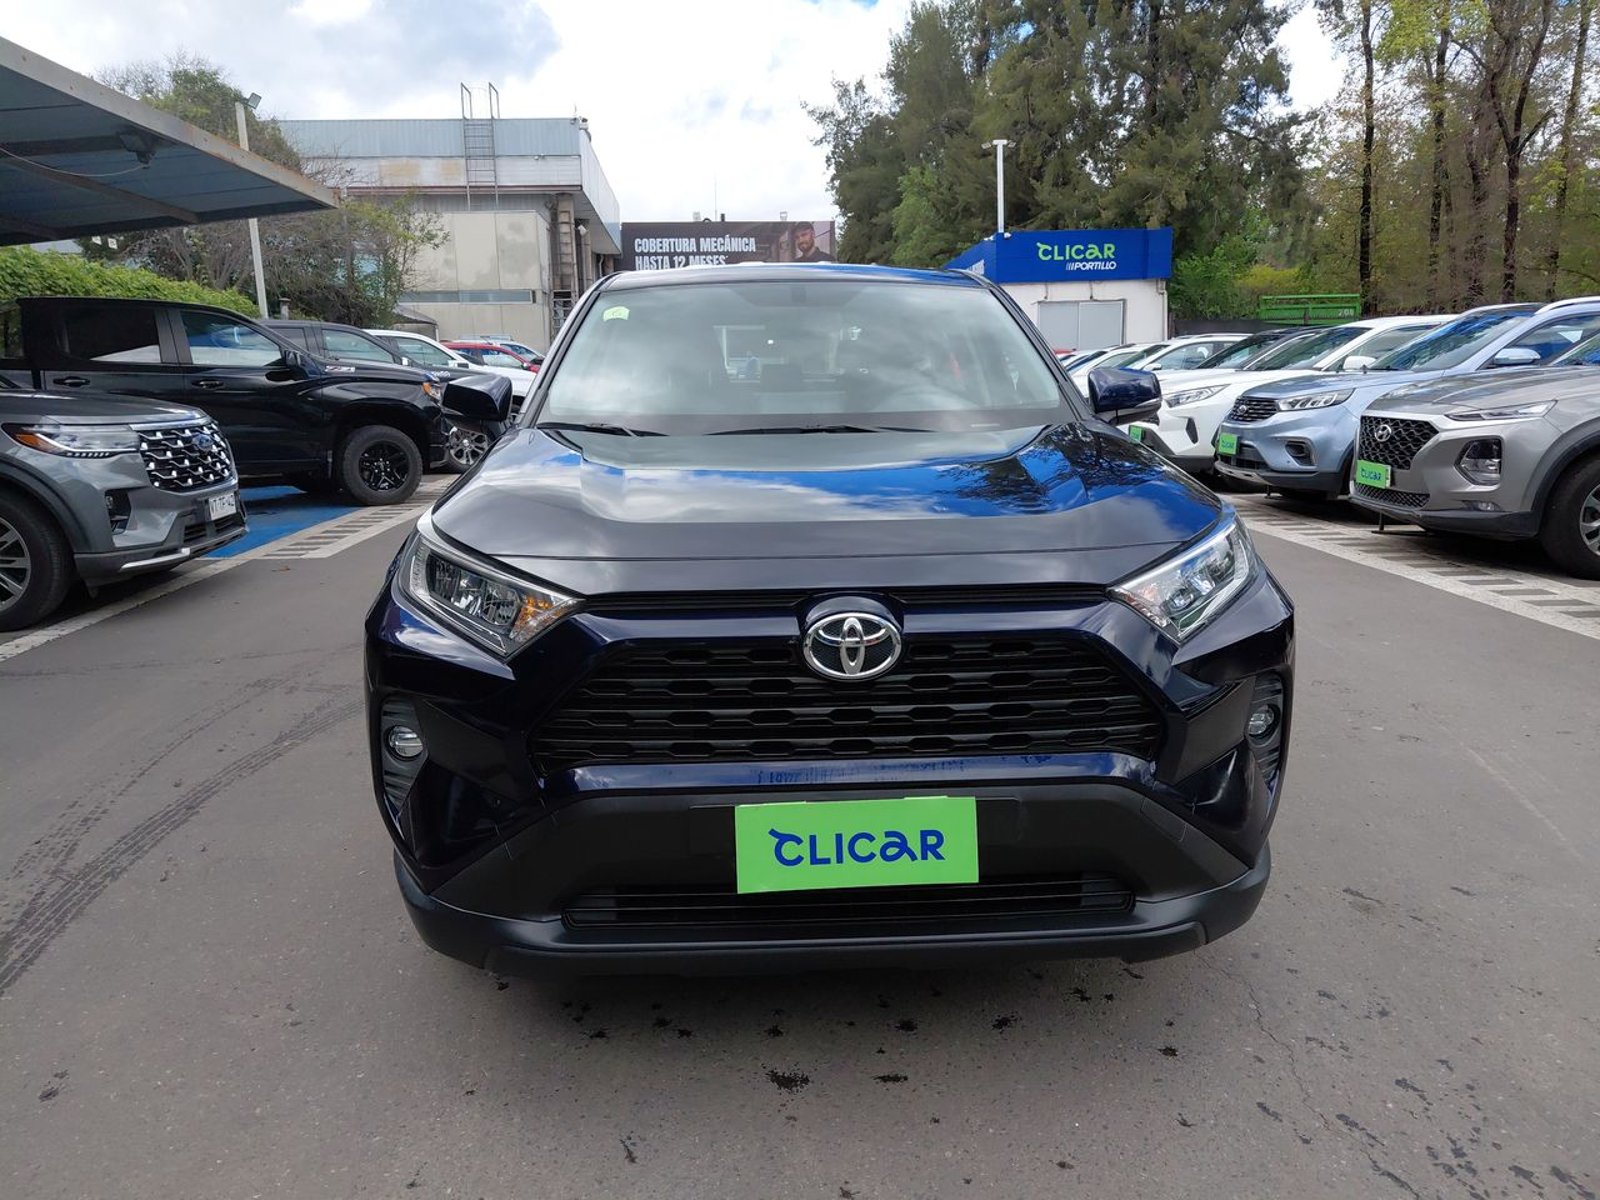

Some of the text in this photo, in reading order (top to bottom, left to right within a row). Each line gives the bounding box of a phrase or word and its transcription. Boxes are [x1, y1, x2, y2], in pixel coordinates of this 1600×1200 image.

[634, 234, 756, 252] COBERTURA MECÁNICA
[634, 255, 670, 271] HASTA
[673, 255, 686, 269] 12
[1073, 261, 1117, 271] PORTILLO
[768, 828, 945, 866] CLICAR
